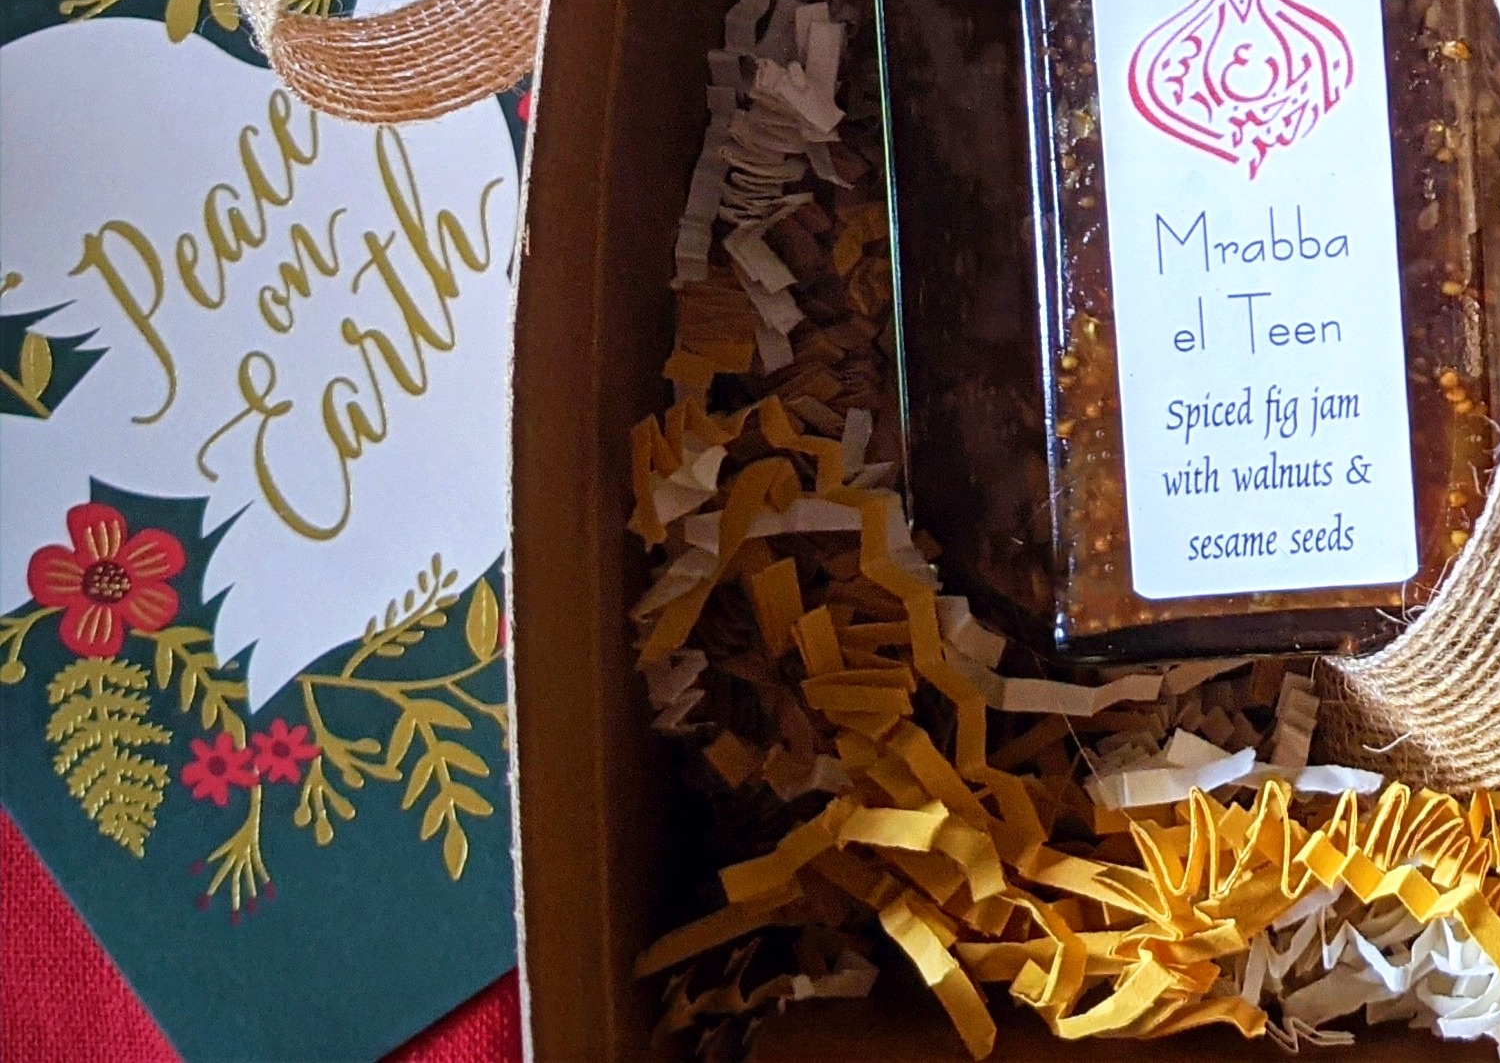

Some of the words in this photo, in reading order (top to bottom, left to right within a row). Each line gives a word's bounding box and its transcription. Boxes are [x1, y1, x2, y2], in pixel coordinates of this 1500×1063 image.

[68, 89, 319, 424] Peace
[259, 208, 348, 333] on
[1156, 205, 1349, 275] Mrabba
[197, 125, 504, 540] Earth
[1173, 296, 1206, 352] el
[1227, 292, 1342, 354] Teen
[1166, 386, 1254, 445] Spiced
[1264, 385, 1300, 440] fig
[1310, 386, 1361, 437] jam
[1162, 455, 1220, 497] with
[1232, 451, 1334, 492] walnuts
[1345, 454, 1373, 484] &
[1188, 527, 1278, 561] sesame
[1289, 512, 1355, 555] seeds
